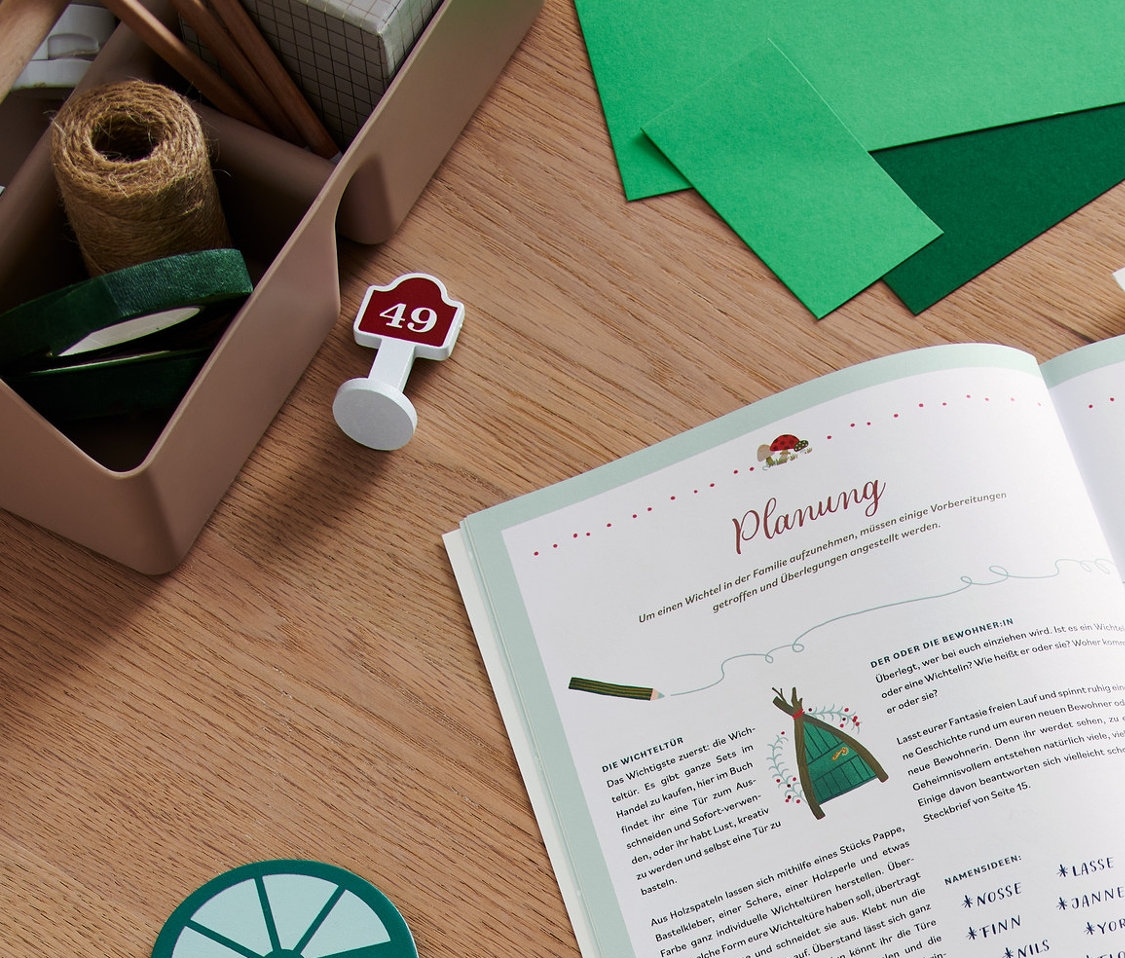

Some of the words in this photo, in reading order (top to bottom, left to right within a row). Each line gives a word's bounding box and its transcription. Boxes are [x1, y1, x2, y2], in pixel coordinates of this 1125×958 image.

[379, 302, 438, 333] 49
[732, 479, 887, 555] Planung
[638, 612, 655, 623] Um
[657, 602, 683, 616] einen
[684, 583, 722, 605] Wichtel
[723, 581, 733, 590] in
[734, 574, 751, 586] der
[753, 559, 788, 578] Familie
[789, 533, 858, 564] aufzunehmen,
[860, 518, 897, 536] müssen
[898, 508, 929, 523] einige
[930, 492, 1007, 513] Vorbereitungen
[712, 588, 758, 614] getroffen
[759, 577, 778, 592] und
[780, 553, 848, 584] Überlegungen
[850, 533, 900, 557] angestellt
[901, 522, 941, 539] werden.
[870, 655, 891, 669] DER
[892, 645, 921, 660] ODER
[922, 638, 940, 650] DIE
[941, 617, 1014, 643] BEWOHNER:IN
[601, 761, 619, 773] DIE
[620, 737, 684, 765] WICHTELTÜR
[606, 777, 625, 789] Das
[625, 757, 676, 781] Wichtigste
[678, 744, 710, 762] zuerst:
[712, 738, 727, 748] die
[727, 727, 756, 741] Wich-
[611, 788, 640, 803] teltür.
[644, 782, 656, 791] Es
[660, 773, 680, 787] gibt
[684, 761, 712, 778] ganze
[715, 751, 737, 764] Sets
[741, 744, 754, 754] im
[651, 915, 669, 927] Aus
[669, 895, 724, 920] Holzspateln
[724, 883, 754, 899] lassen
[755, 874, 775, 888] sich
[776, 860, 812, 879] mithilfe
[813, 851, 838, 865] eines
[839, 838, 871, 855] Stücks
[872, 826, 906, 842] Pappe,
[944, 854, 1022, 885] NAMENSIDEEN:
[1071, 856, 1115, 877] LASSE
[976, 881, 1023, 907] NOSSE
[1071, 886, 1125, 910] JANNE
[979, 915, 1022, 939] FINN
